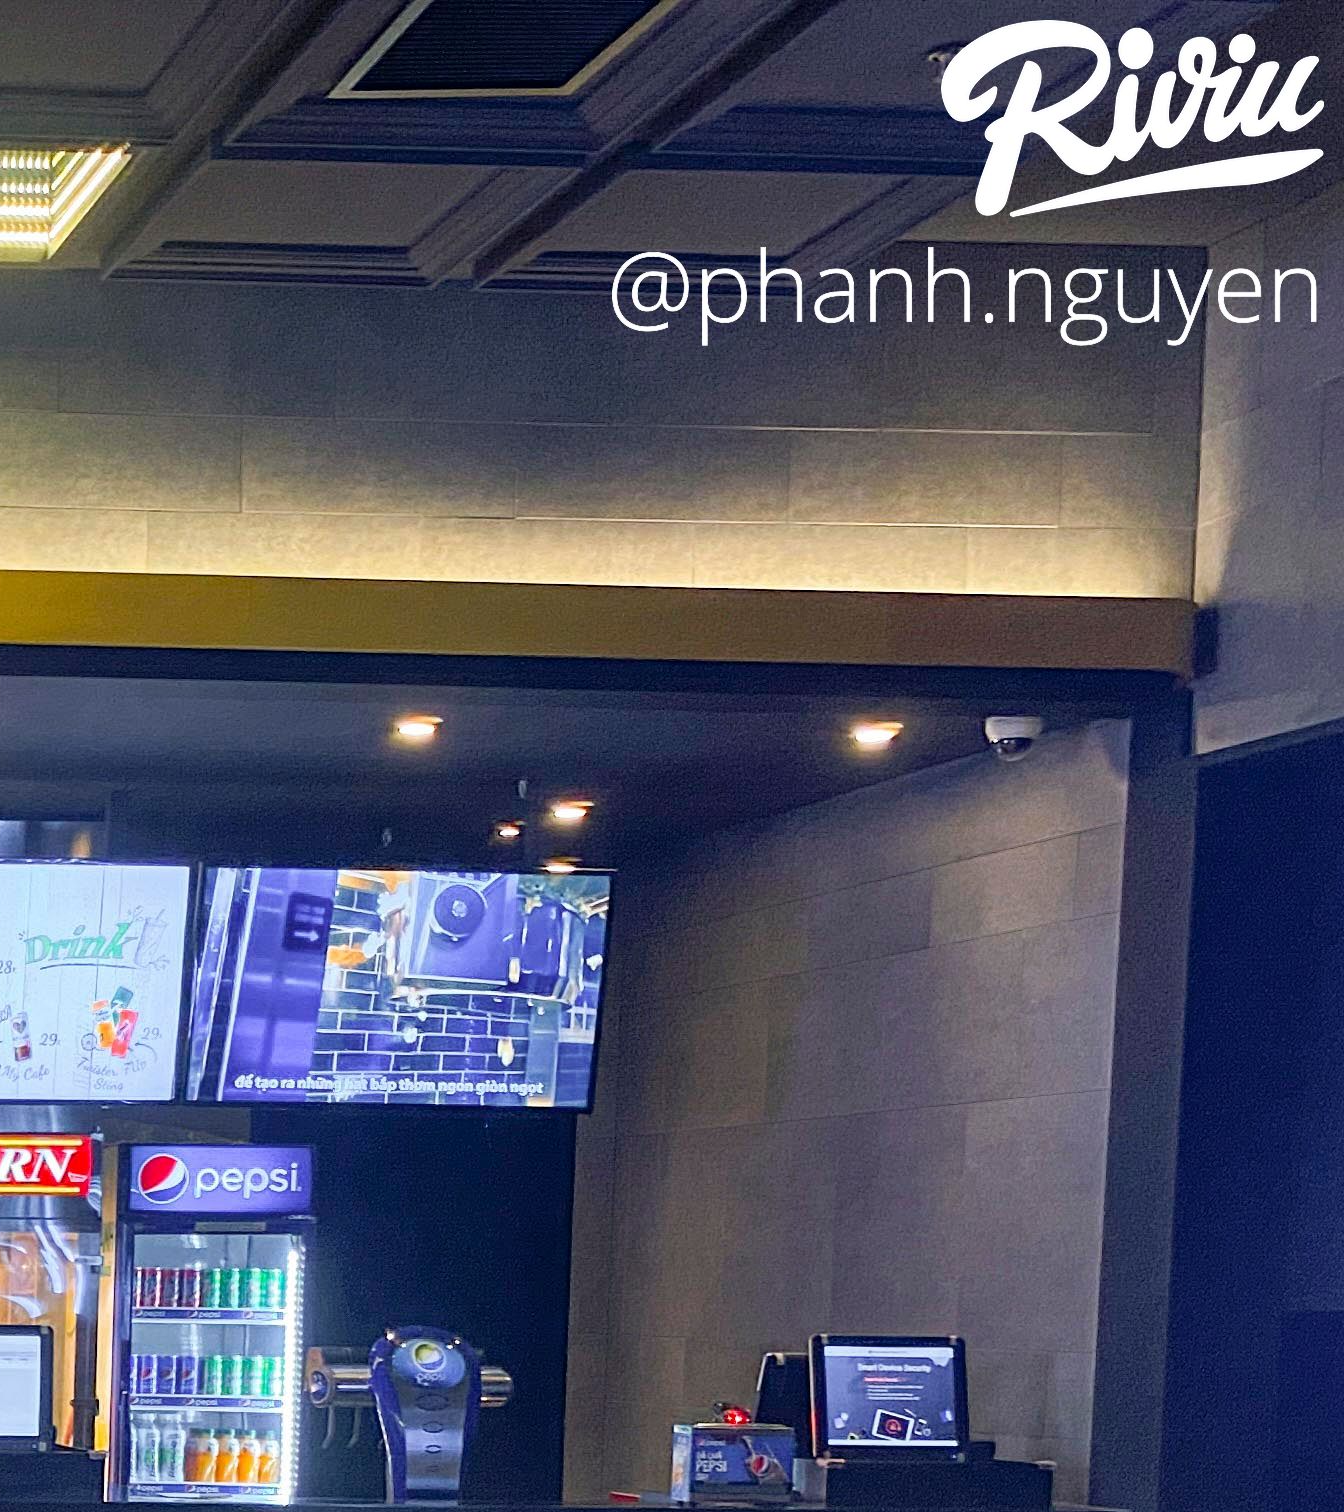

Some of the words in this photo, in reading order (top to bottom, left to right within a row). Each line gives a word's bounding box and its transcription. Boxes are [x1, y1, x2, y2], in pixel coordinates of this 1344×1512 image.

[24, 922, 138, 964] Drink
[255, 1076, 279, 1092] tạo
[280, 1078, 296, 1089] ra
[437, 1081, 474, 1094] ngon
[193, 1162, 299, 1200] pepsi
